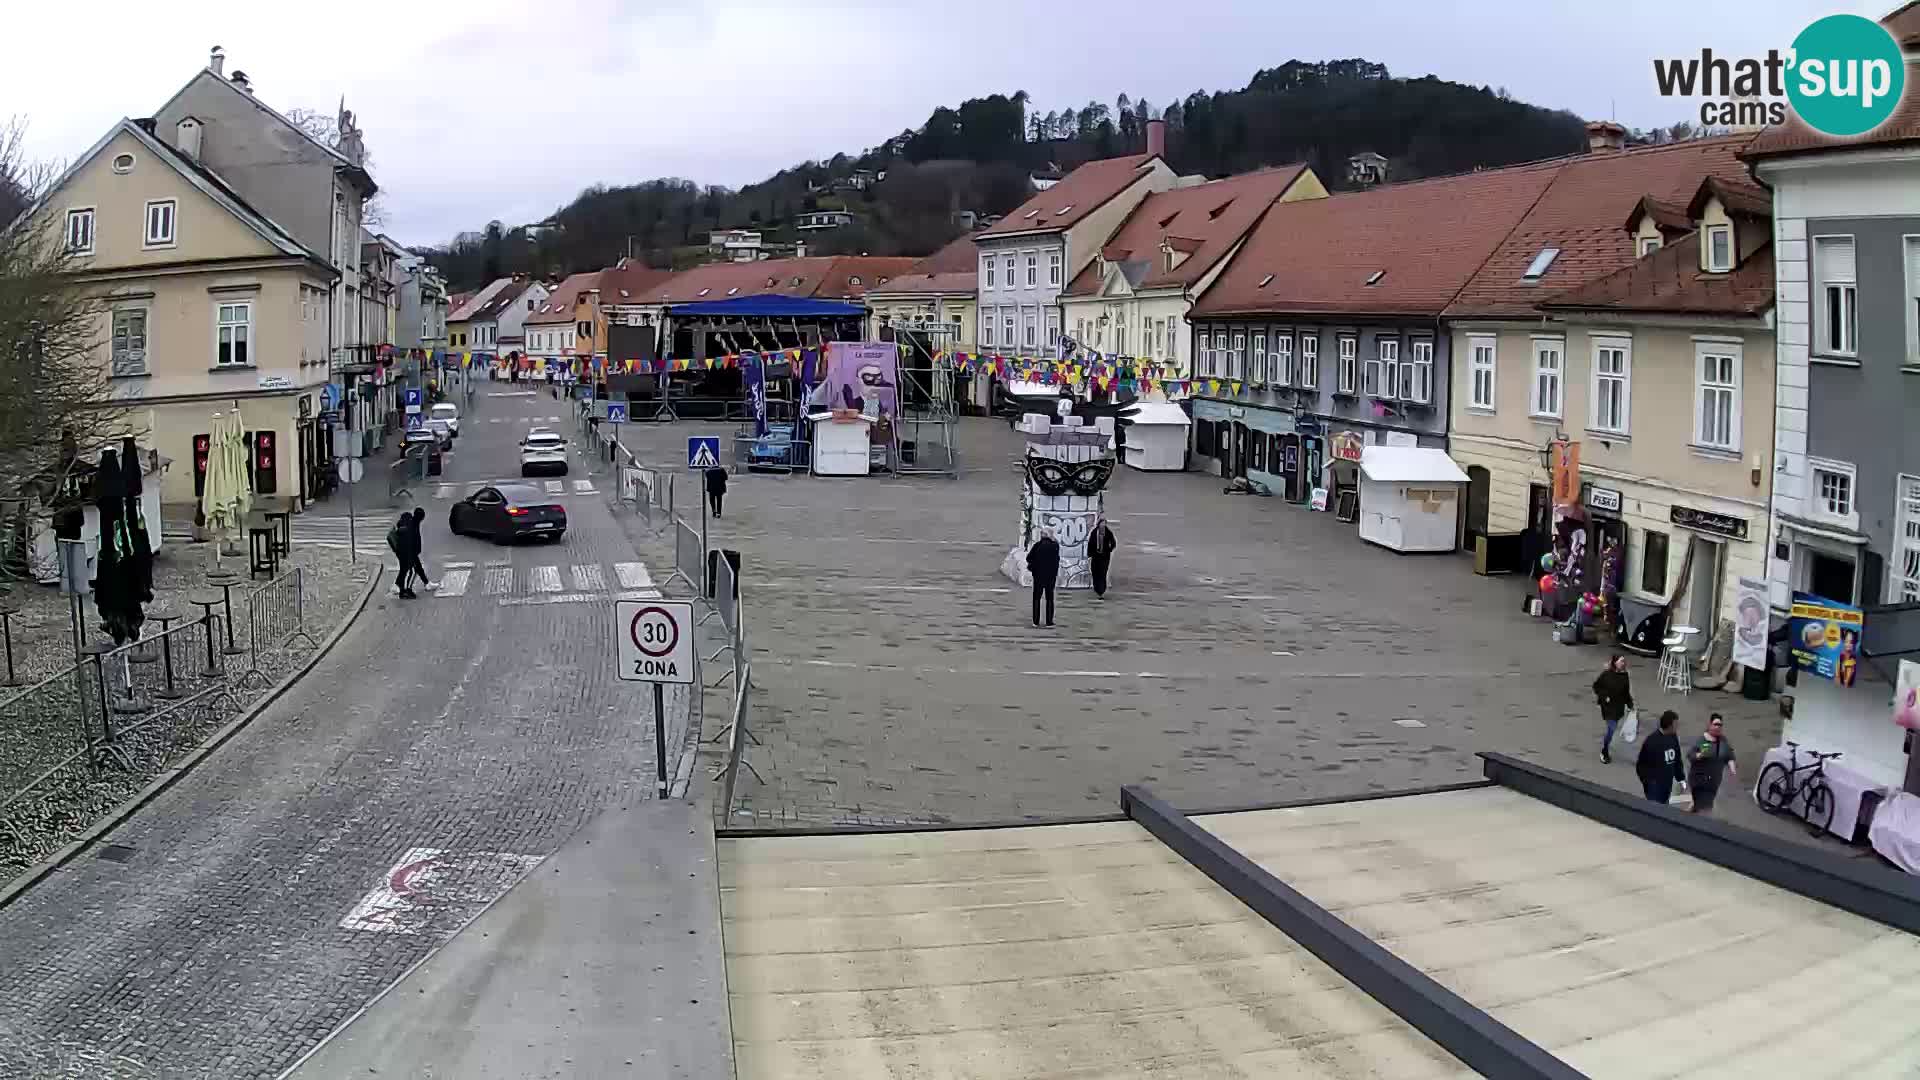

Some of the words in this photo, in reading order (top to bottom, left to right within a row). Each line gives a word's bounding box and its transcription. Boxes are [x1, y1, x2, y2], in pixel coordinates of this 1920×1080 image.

[409, 391, 417, 403] P
[643, 622, 667, 643] 30
[634, 659, 678, 676] ZONA
[1664, 748, 1676, 762] 10
